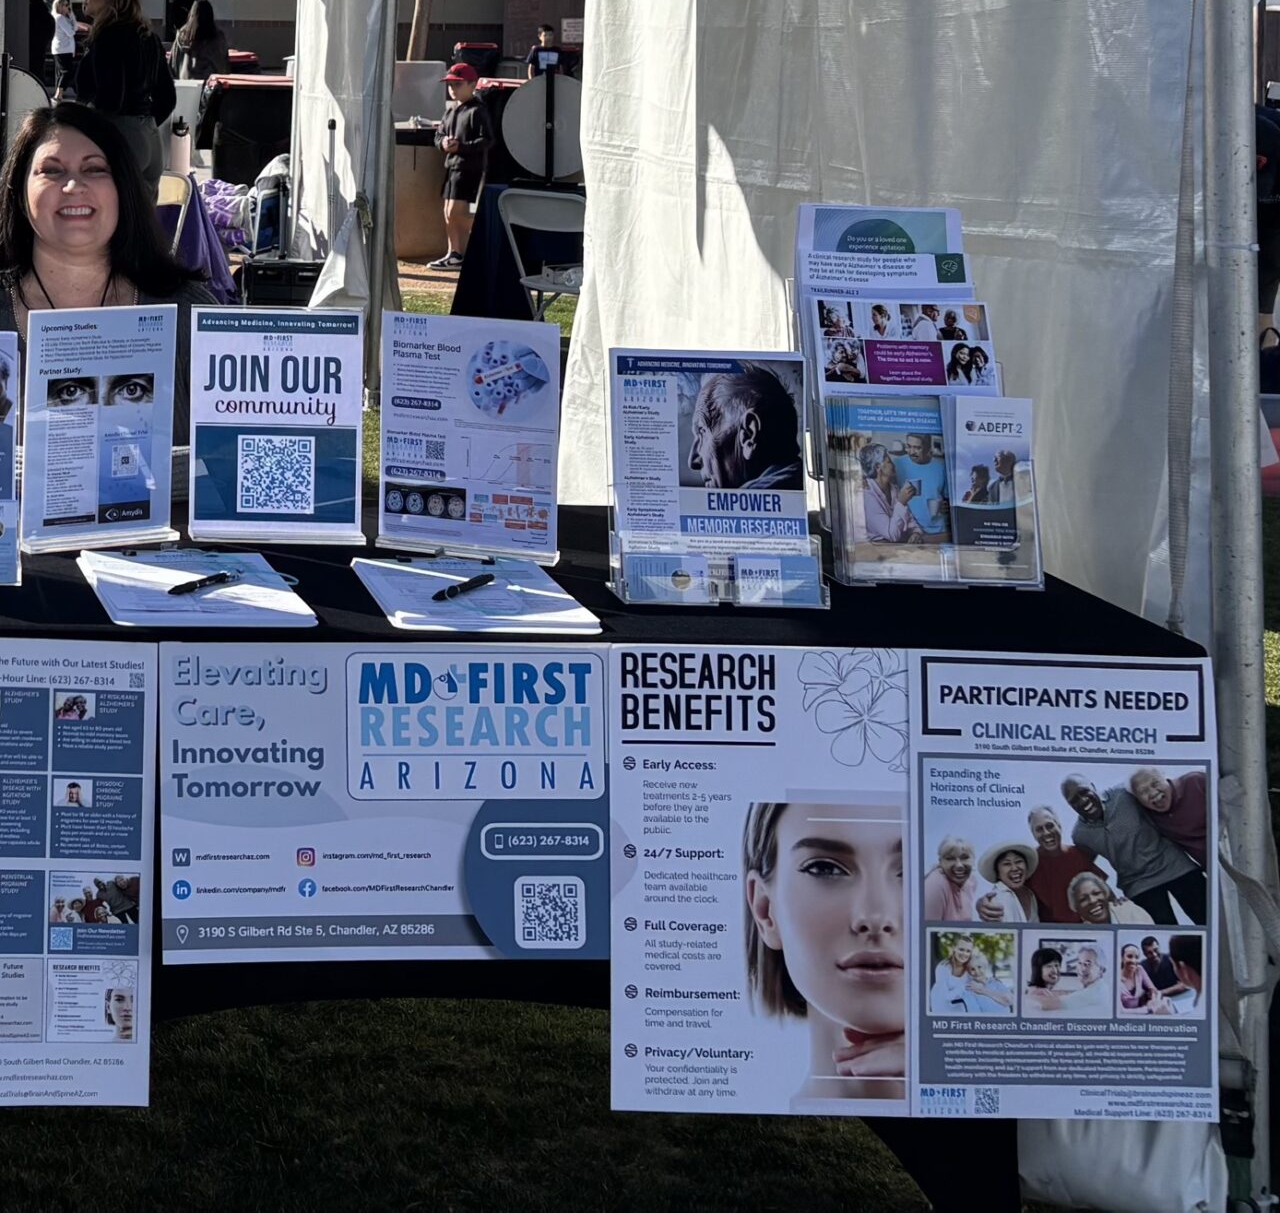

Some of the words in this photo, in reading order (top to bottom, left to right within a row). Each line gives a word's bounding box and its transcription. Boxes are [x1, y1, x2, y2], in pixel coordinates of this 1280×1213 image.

[41, 325, 72, 333] Upcoming
[202, 319, 238, 327] Advancing
[393, 341, 435, 351] Biomarker
[438, 343, 461, 353] Blood
[393, 350, 422, 360] Plasma
[425, 351, 441, 361] Test
[63, 367, 82, 375] Study:
[204, 354, 269, 392] JOIN
[281, 356, 342, 394] OUR
[215, 397, 336, 425] community
[978, 422, 1022, 433] ADEPT-2
[707, 492, 781, 512] EMPOWER
[687, 517, 737, 535] MEMORY
[740, 519, 800, 536] RESEARCH
[12, 657, 39, 666] Future
[41, 658, 60, 667] with
[62, 659, 78, 667] Our
[81, 659, 107, 669] Latest
[110, 661, 145, 670] Studies!
[172, 655, 327, 694] Elevating
[621, 652, 775, 690] RESEARCH
[26, 674, 47, 683] Line:
[49, 675, 71, 685] (623)
[74, 676, 115, 685] 267-8314
[358, 663, 431, 704] MD
[469, 663, 591, 704] FIRST
[939, 685, 1097, 709] PARTICIPANTS
[1104, 691, 1189, 711] NEEDED
[175, 697, 266, 730] Care,
[621, 694, 775, 732] BENEFITS
[361, 706, 591, 747] RESEARCH
[972, 722, 1055, 740] CLINICAL
[1060, 726, 1157, 744] RESEARCH
[172, 739, 324, 770] Innovating
[643, 759, 671, 771] Early
[674, 760, 717, 770] Access:
[360, 761, 594, 790] ARIZONA
[930, 768, 982, 780] Expanding
[984, 770, 1000, 779] the
[172, 773, 322, 798] Tomorrow
[643, 780, 677, 788] Receive
[931, 783, 974, 792] Horizons
[977, 784, 987, 793] of
[989, 784, 1025, 794] Clinical
[643, 792, 690, 800] treatments
[692, 794, 706, 802] 2-5
[708, 794, 732, 802] years
[931, 797, 974, 806] Research
[977, 797, 1021, 807] Inclusion
[643, 803, 671, 811] before
[674, 804, 693, 813] they
[695, 815, 709, 823] the
[643, 826, 671, 835] public.
[508, 834, 537, 847] (623)
[540, 835, 589, 847] 267-8314
[644, 848, 672, 859] 24/7
[675, 848, 724, 860] Support:
[198, 927, 225, 937] 3190
[228, 927, 235, 936] S
[239, 925, 274, 936] Gilbert
[277, 925, 292, 936] Rd
[295, 925, 313, 936] Ste
[316, 925, 325, 937] 5,
[329, 925, 379, 936] Chandler,
[383, 925, 398, 935] AZ
[400, 924, 434, 935] 85286
[644, 920, 666, 930] Full
[669, 921, 727, 934] Coverage:
[645, 988, 740, 1000] Reimbursement:
[645, 1047, 753, 1060] Privacy/Voluntary:
